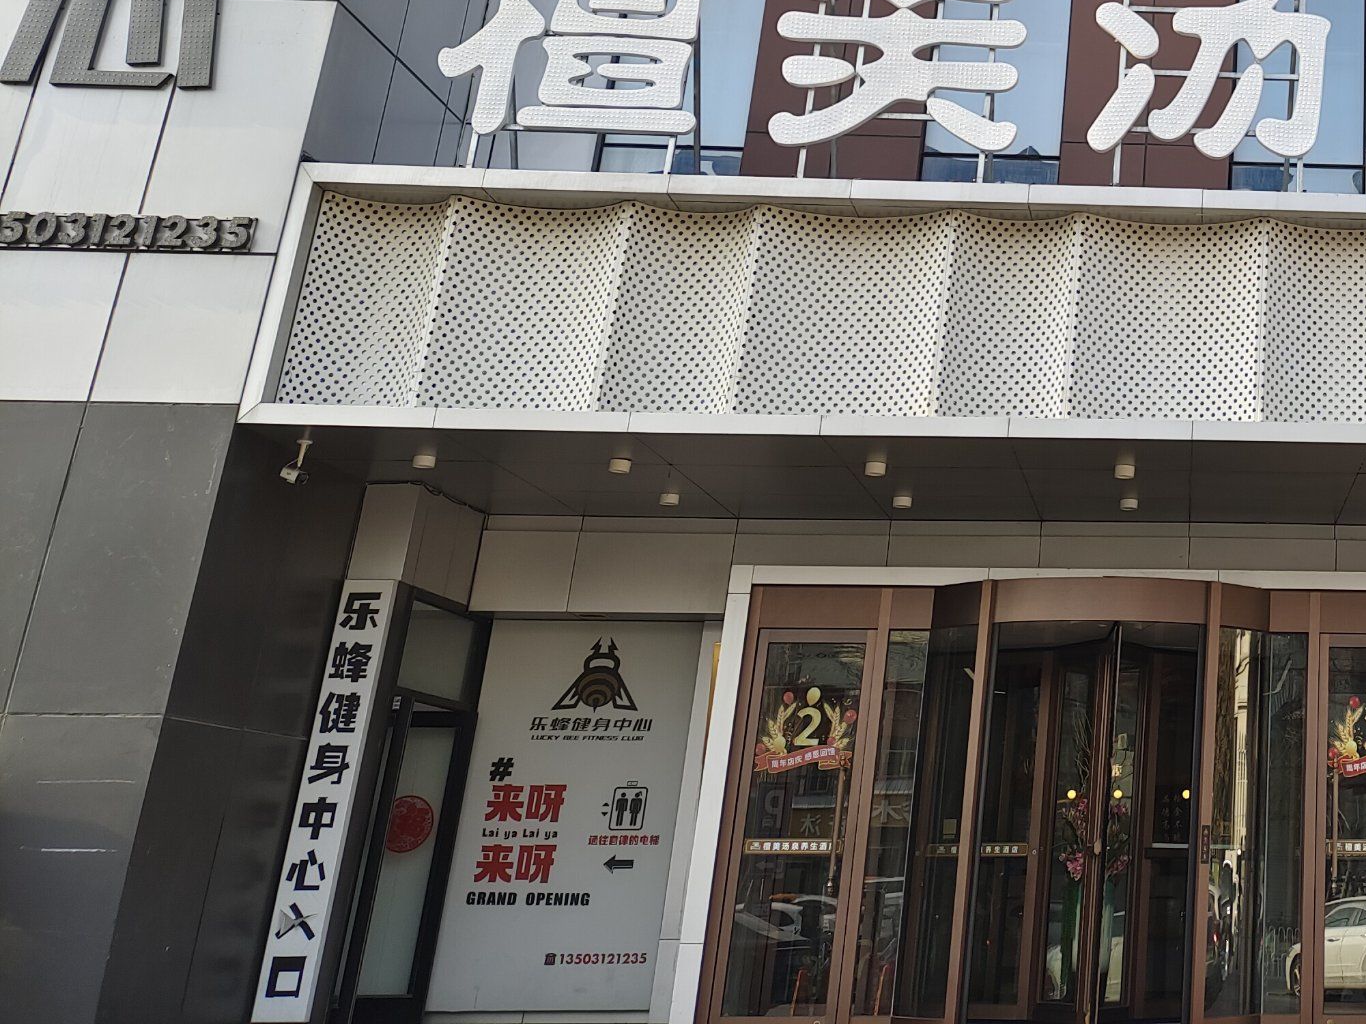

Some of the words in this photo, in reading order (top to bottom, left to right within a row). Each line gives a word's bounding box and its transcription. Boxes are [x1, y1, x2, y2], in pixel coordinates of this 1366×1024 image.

[530, 717, 653, 731] 乐蜂健身中心
[794, 706, 822, 746] 2
[266, 592, 382, 998] 乐蜂健身中心入口
[485, 784, 567, 822] 来呀
[482, 828, 499, 838] Lai
[504, 830, 517, 839] ya
[522, 828, 539, 838] Lai
[545, 830, 558, 839] ya
[474, 844, 557, 883] 来呀
[466, 892, 517, 906] GRAND
[525, 892, 590, 906] OPENING
[560, 953, 647, 964] 13503121235
